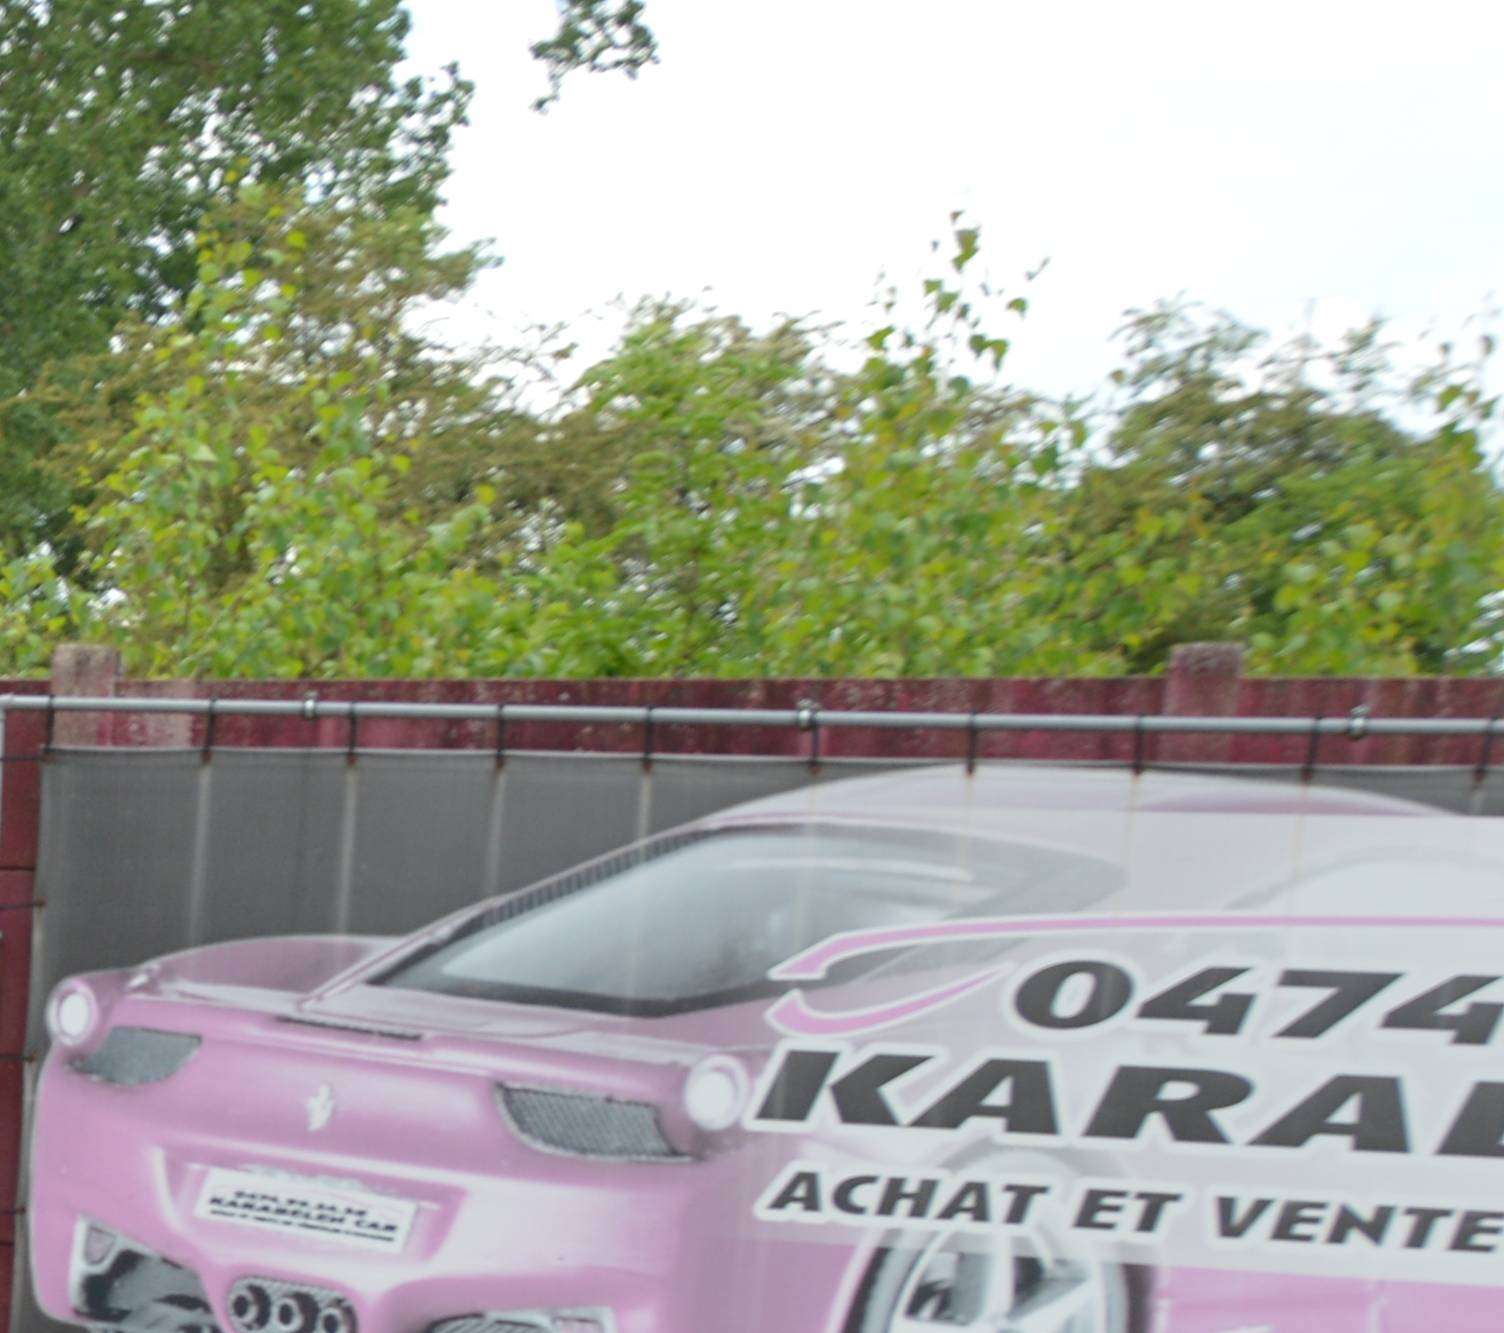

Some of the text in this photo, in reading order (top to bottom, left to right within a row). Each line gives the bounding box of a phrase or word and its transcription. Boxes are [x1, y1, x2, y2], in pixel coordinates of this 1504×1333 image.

[1013, 958, 1504, 1045] 0474
[768, 1170, 1504, 1253] ACHAT ET VENTE
